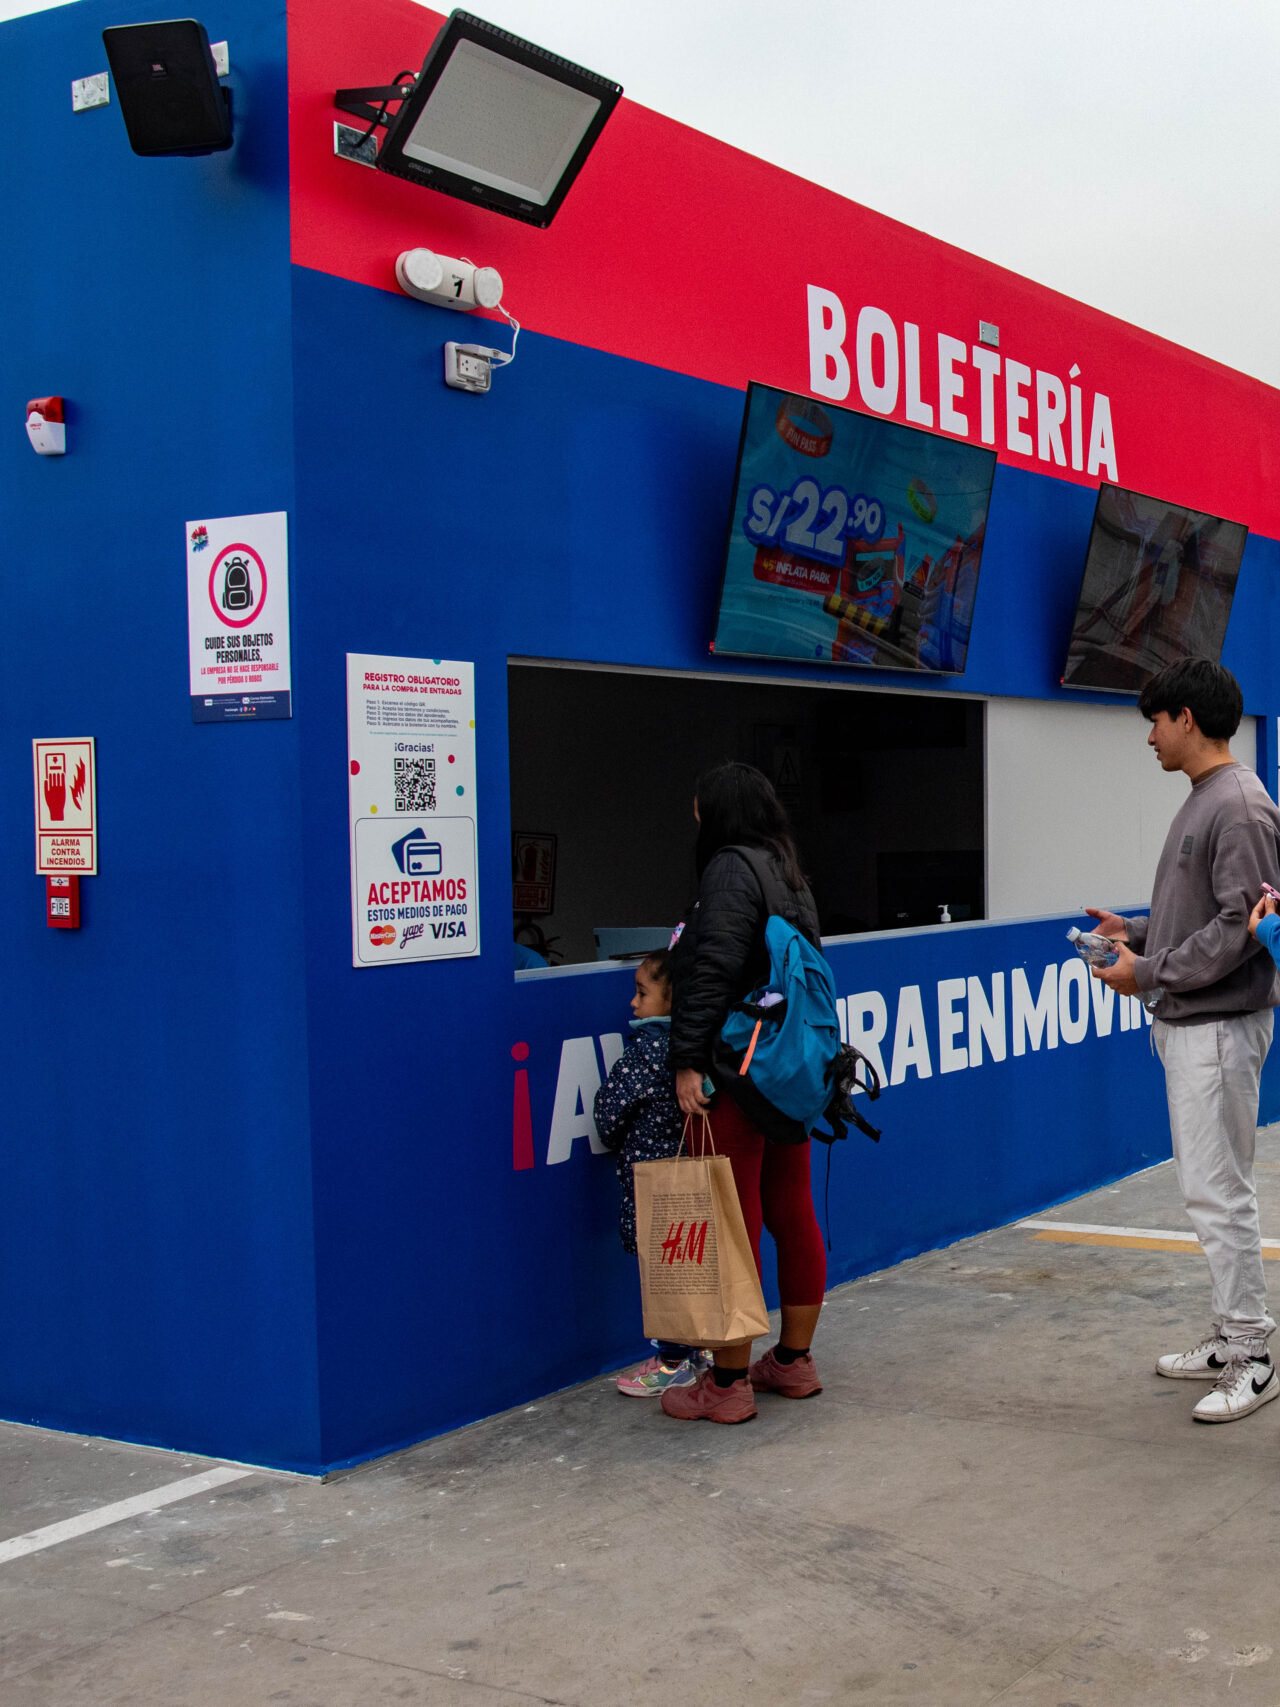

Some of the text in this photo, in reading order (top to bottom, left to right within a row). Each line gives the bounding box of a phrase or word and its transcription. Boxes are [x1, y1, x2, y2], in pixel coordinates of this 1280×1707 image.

[454, 280, 464, 298] 1
[807, 284, 1118, 482] BOLETERÍA
[776, 561, 808, 580] INFLATA
[810, 570, 830, 584] PARK
[204, 632, 274, 650] CUIDE SUS OBJETOS
[216, 648, 262, 663] PERSONALES,
[207, 666, 226, 674] EMPRESA
[240, 664, 250, 672] HACE
[251, 662, 279, 672] RESPONSABLE
[364, 672, 460, 686] REGISTRO OBLIGATORIO
[430, 688, 462, 696] ENTRADAS
[394, 742, 434, 753] ¡Gracias!
[51, 848, 80, 856] CONTRA
[368, 878, 466, 905] ACEPTAMOS
[52, 902, 69, 913] FIRE
[368, 904, 468, 922] ESTOS MEDIOS DE PAGO
[400, 923, 424, 950] yape
[428, 921, 467, 940] VISA
[938, 972, 1006, 1074] EN
[661, 1220, 708, 1266] H&M
